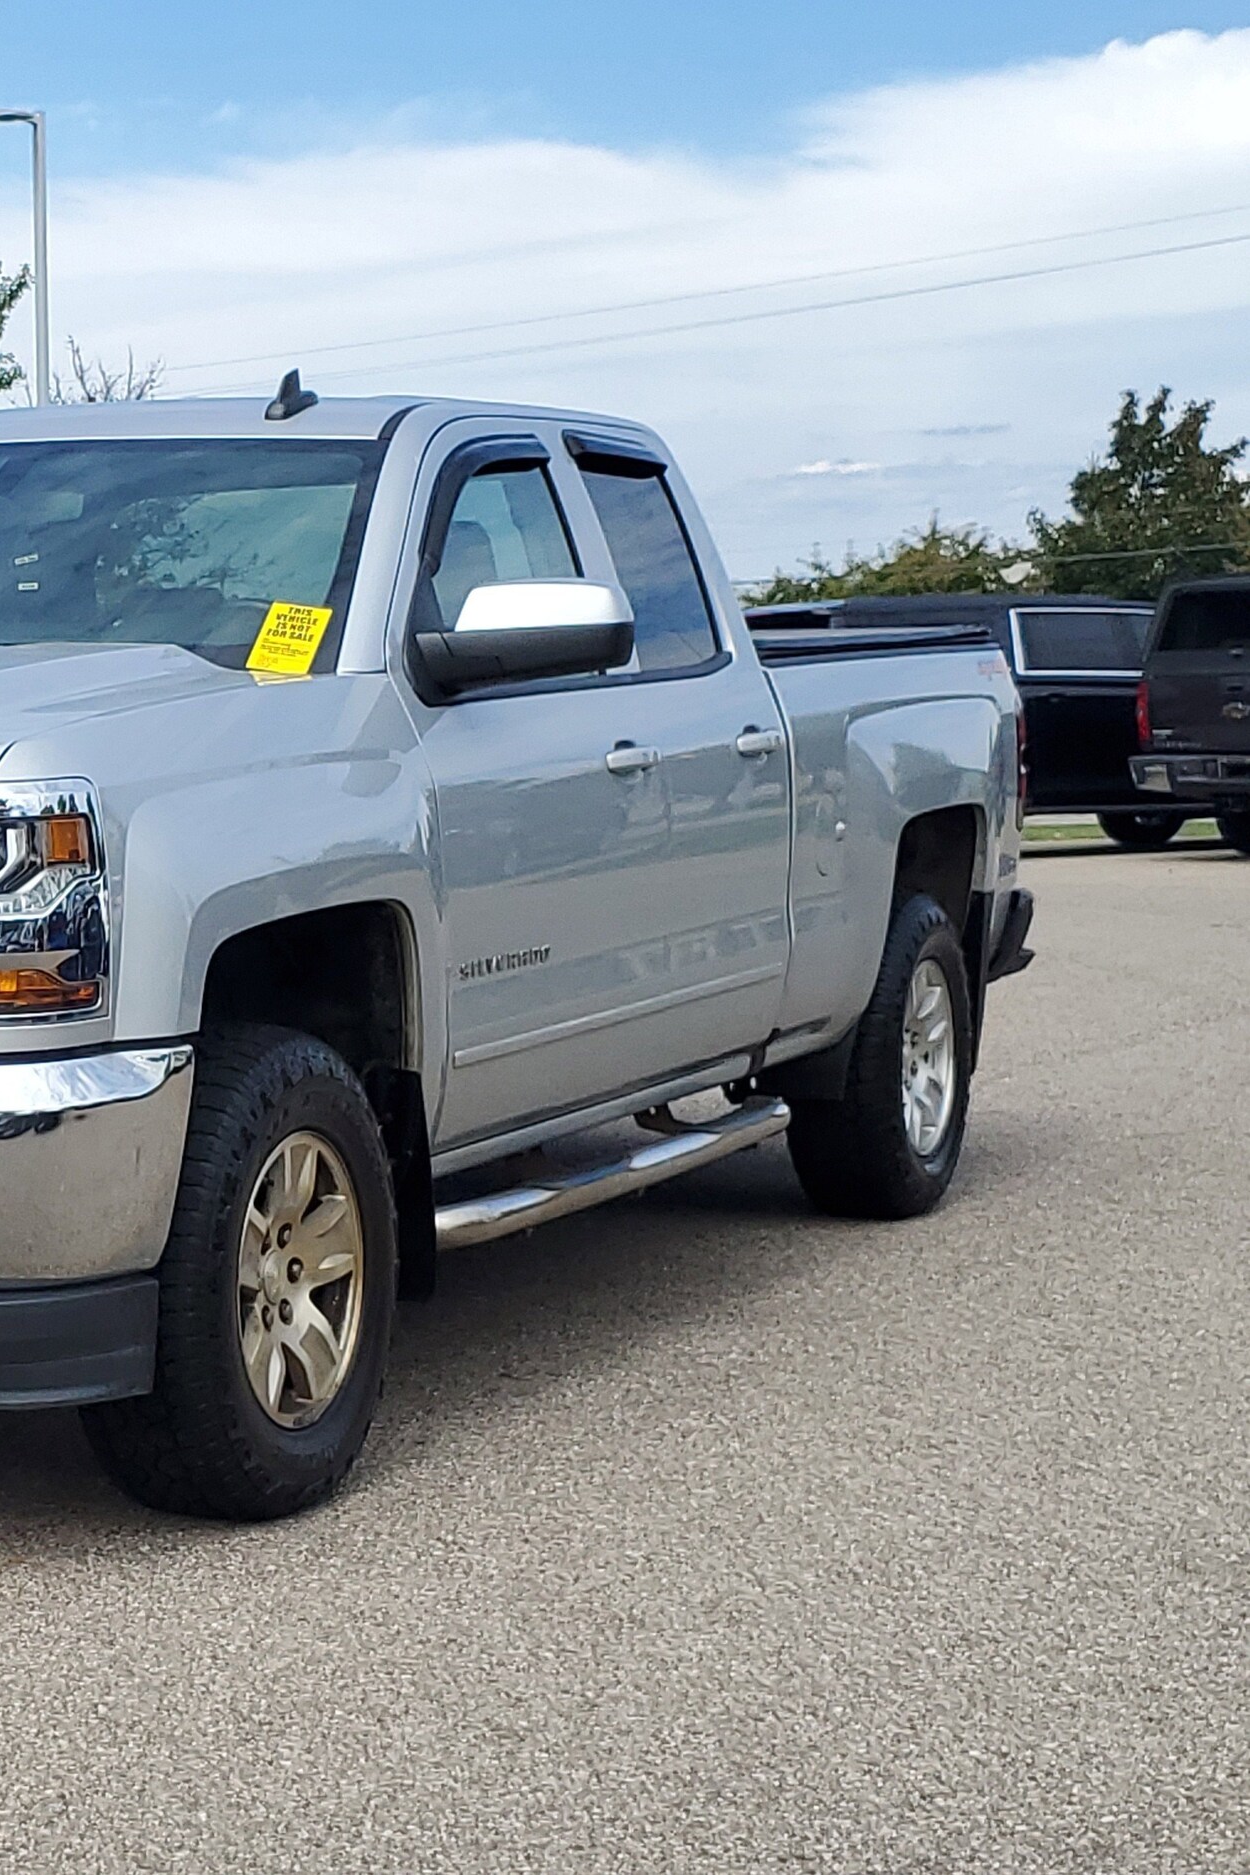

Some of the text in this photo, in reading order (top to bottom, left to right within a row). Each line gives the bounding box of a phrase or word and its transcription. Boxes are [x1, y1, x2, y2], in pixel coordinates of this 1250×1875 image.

[288, 606, 313, 617] THIS
[276, 613, 319, 626] VEHICLE
[276, 621, 312, 633] IS NOT
[266, 628, 288, 638] FOR
[288, 631, 315, 643] SALE
